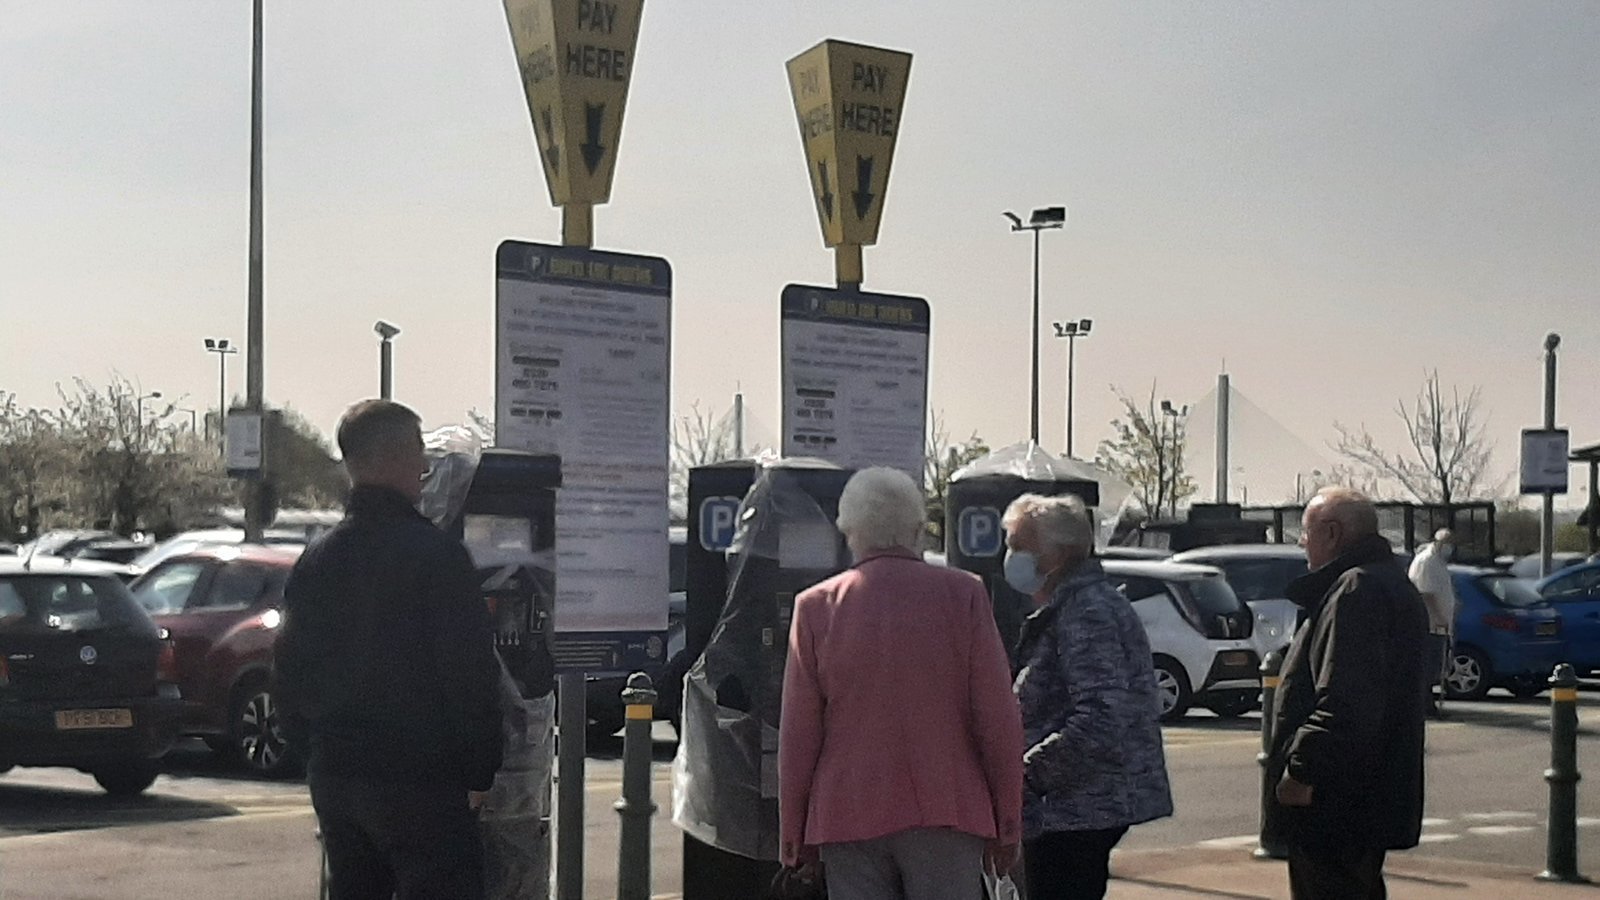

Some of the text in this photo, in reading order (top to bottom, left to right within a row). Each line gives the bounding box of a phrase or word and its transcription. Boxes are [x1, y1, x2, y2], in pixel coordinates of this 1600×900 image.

[577, 0, 618, 34] PAY
[566, 42, 626, 81] HERE
[852, 61, 888, 95] PAY
[841, 100, 893, 137] HERE
[712, 505, 733, 542] P
[970, 514, 992, 549] P
